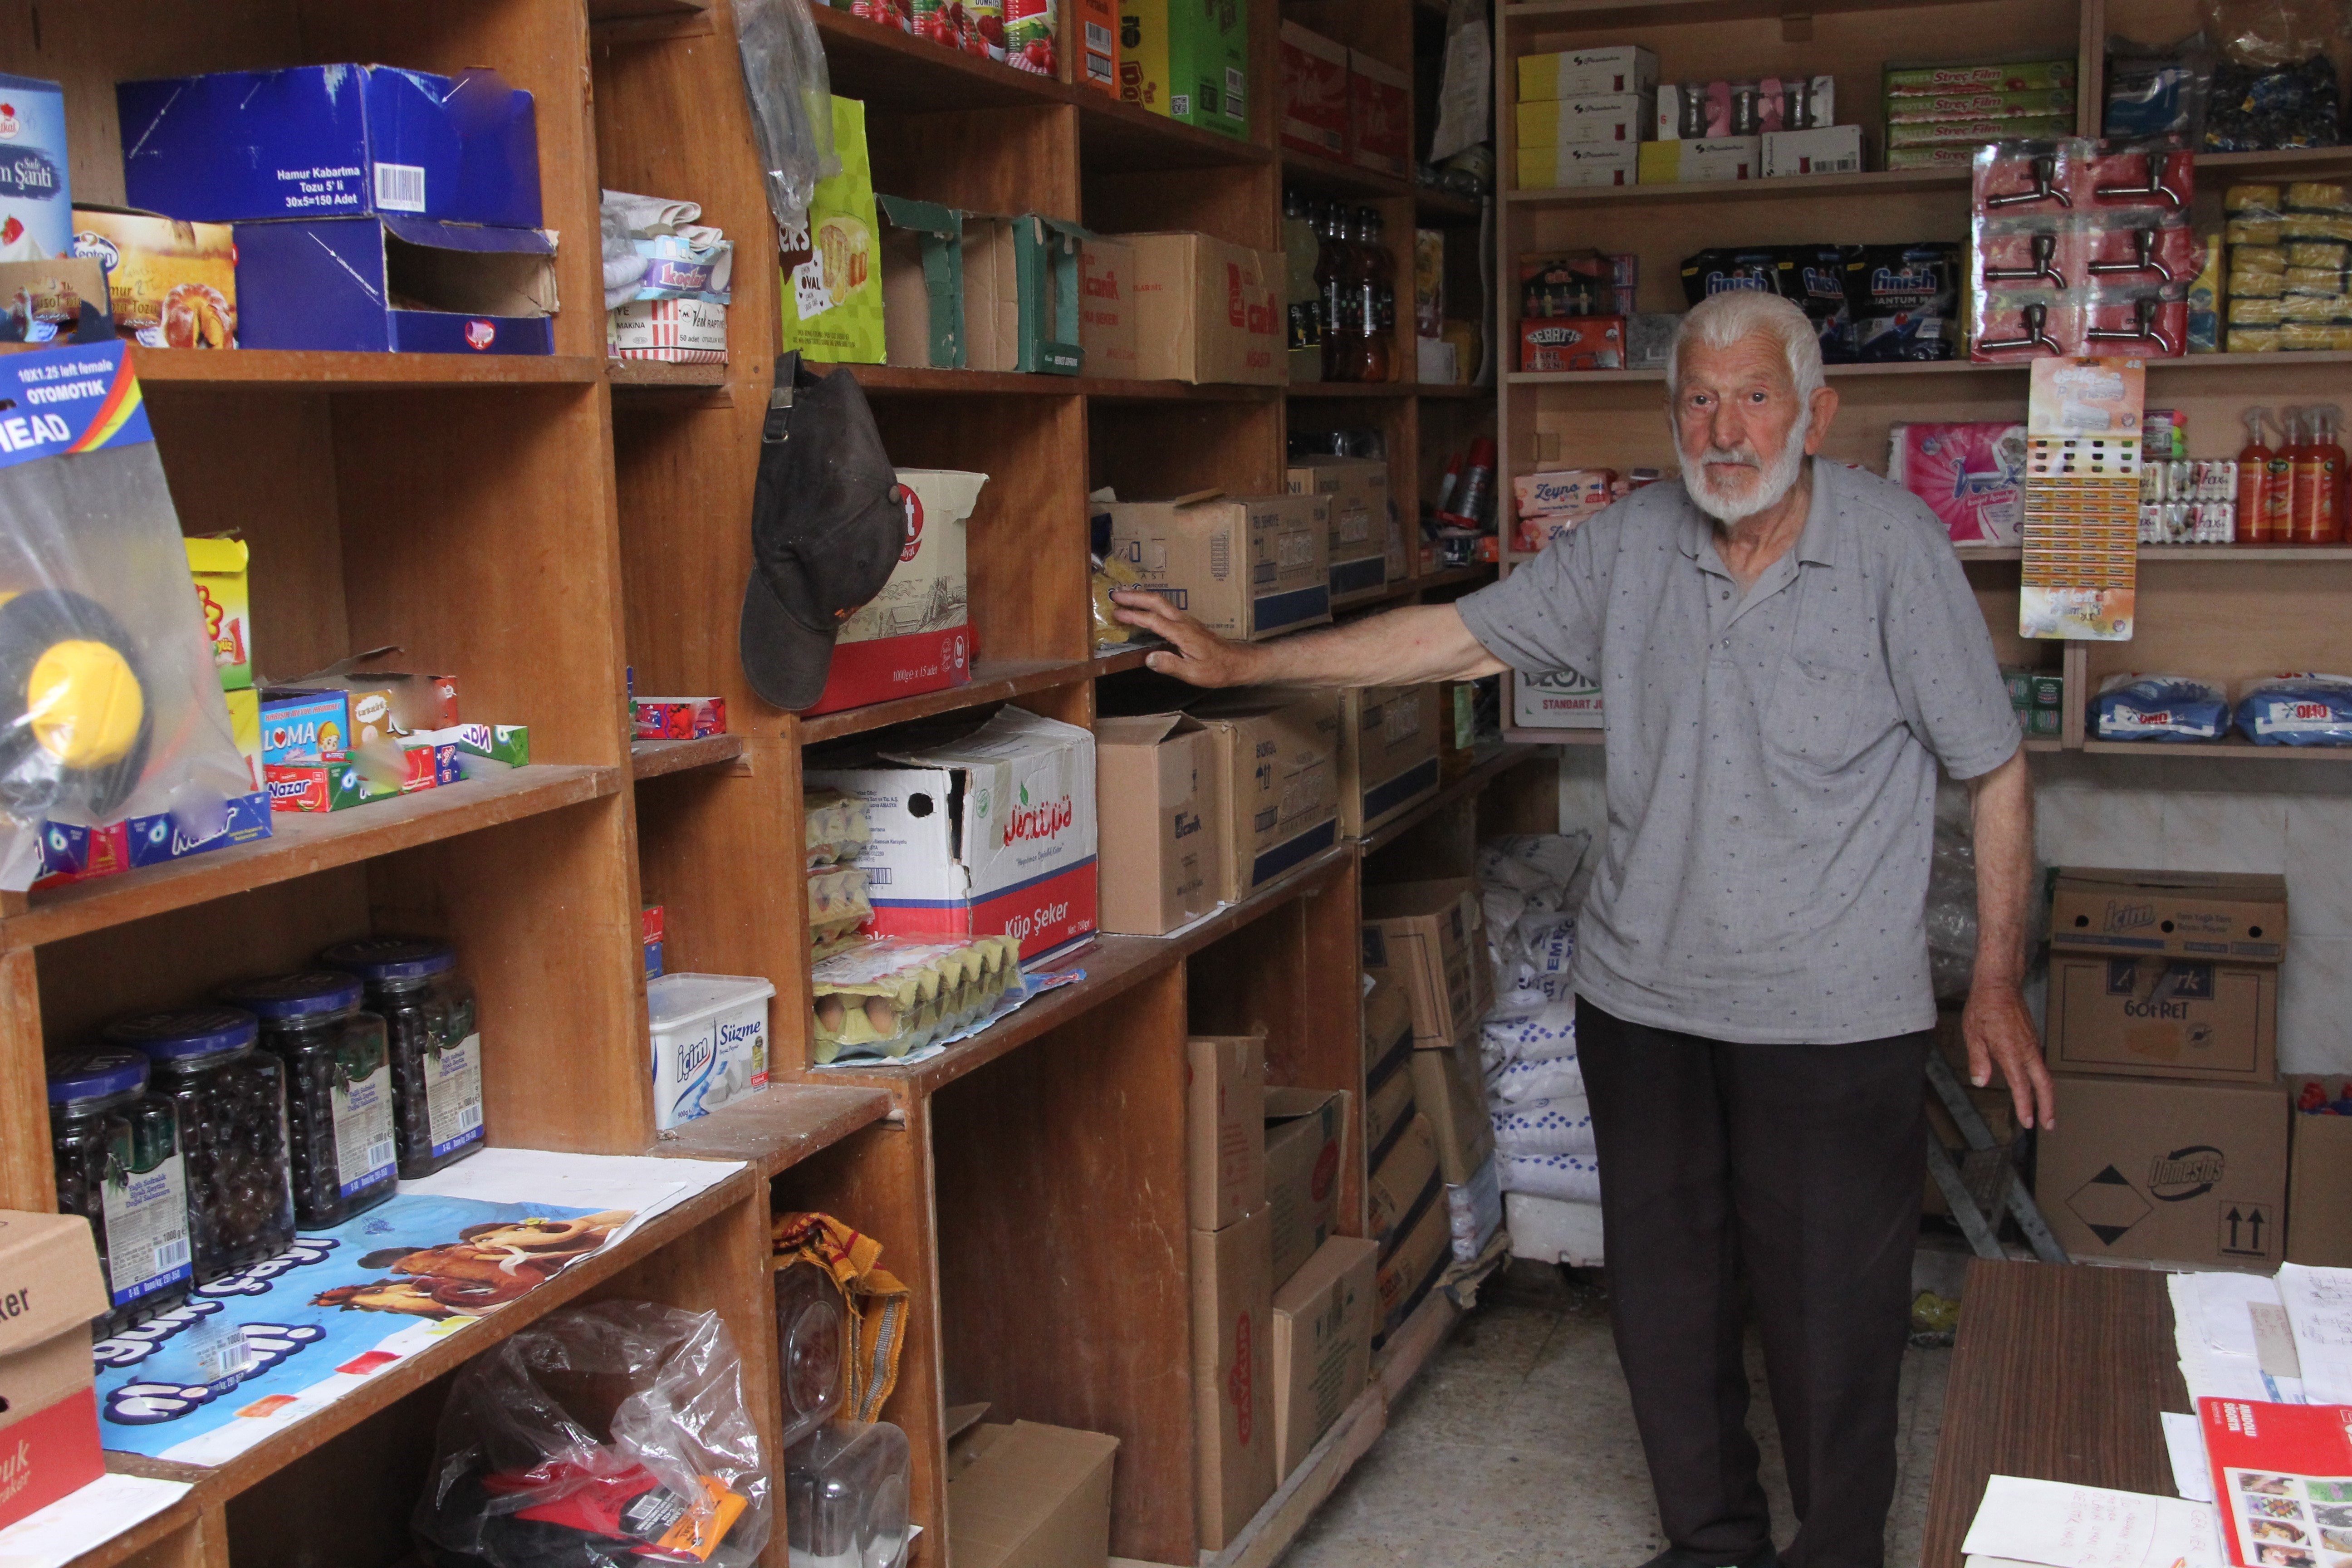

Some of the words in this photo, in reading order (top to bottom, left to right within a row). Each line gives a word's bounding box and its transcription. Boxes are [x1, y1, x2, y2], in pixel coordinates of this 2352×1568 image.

[1972, 69, 2001, 81] Film
[1972, 97, 2001, 108] Film
[1972, 123, 2001, 134] Film
[15, 161, 52, 190] Şanti
[277, 169, 310, 181] Hamur
[313, 166, 361, 179] Kabartma
[300, 181, 323, 193] Tozu
[286, 196, 333, 208] 30x5=150
[334, 194, 358, 205] Adet
[801, 276, 821, 290] OVAL
[1872, 268, 1936, 289] finish
[18, 368, 59, 383] 10X1.25
[60, 364, 78, 377] left
[78, 359, 113, 375] female
[1535, 484, 1579, 501] Zeyno
[1543, 700, 1590, 709] STANDART
[2297, 704, 2327, 719] OMO
[265, 712, 289, 721] KARIŞIK
[291, 708, 312, 717] MEYVE
[2138, 713, 2167, 725] OMO
[263, 721, 316, 751] LOMA
[268, 779, 313, 799] Nazar
[1005, 915, 1030, 939] Küp
[1034, 901, 1068, 936] Şeker
[720, 1021, 761, 1046] Süzme
[2147, 1154, 2225, 1188] Domestos
[163, 1229, 176, 1242] 1000
[2223, 1402, 2239, 1431] SİGORTA
[2238, 1403, 2256, 1436] ANADOLU
